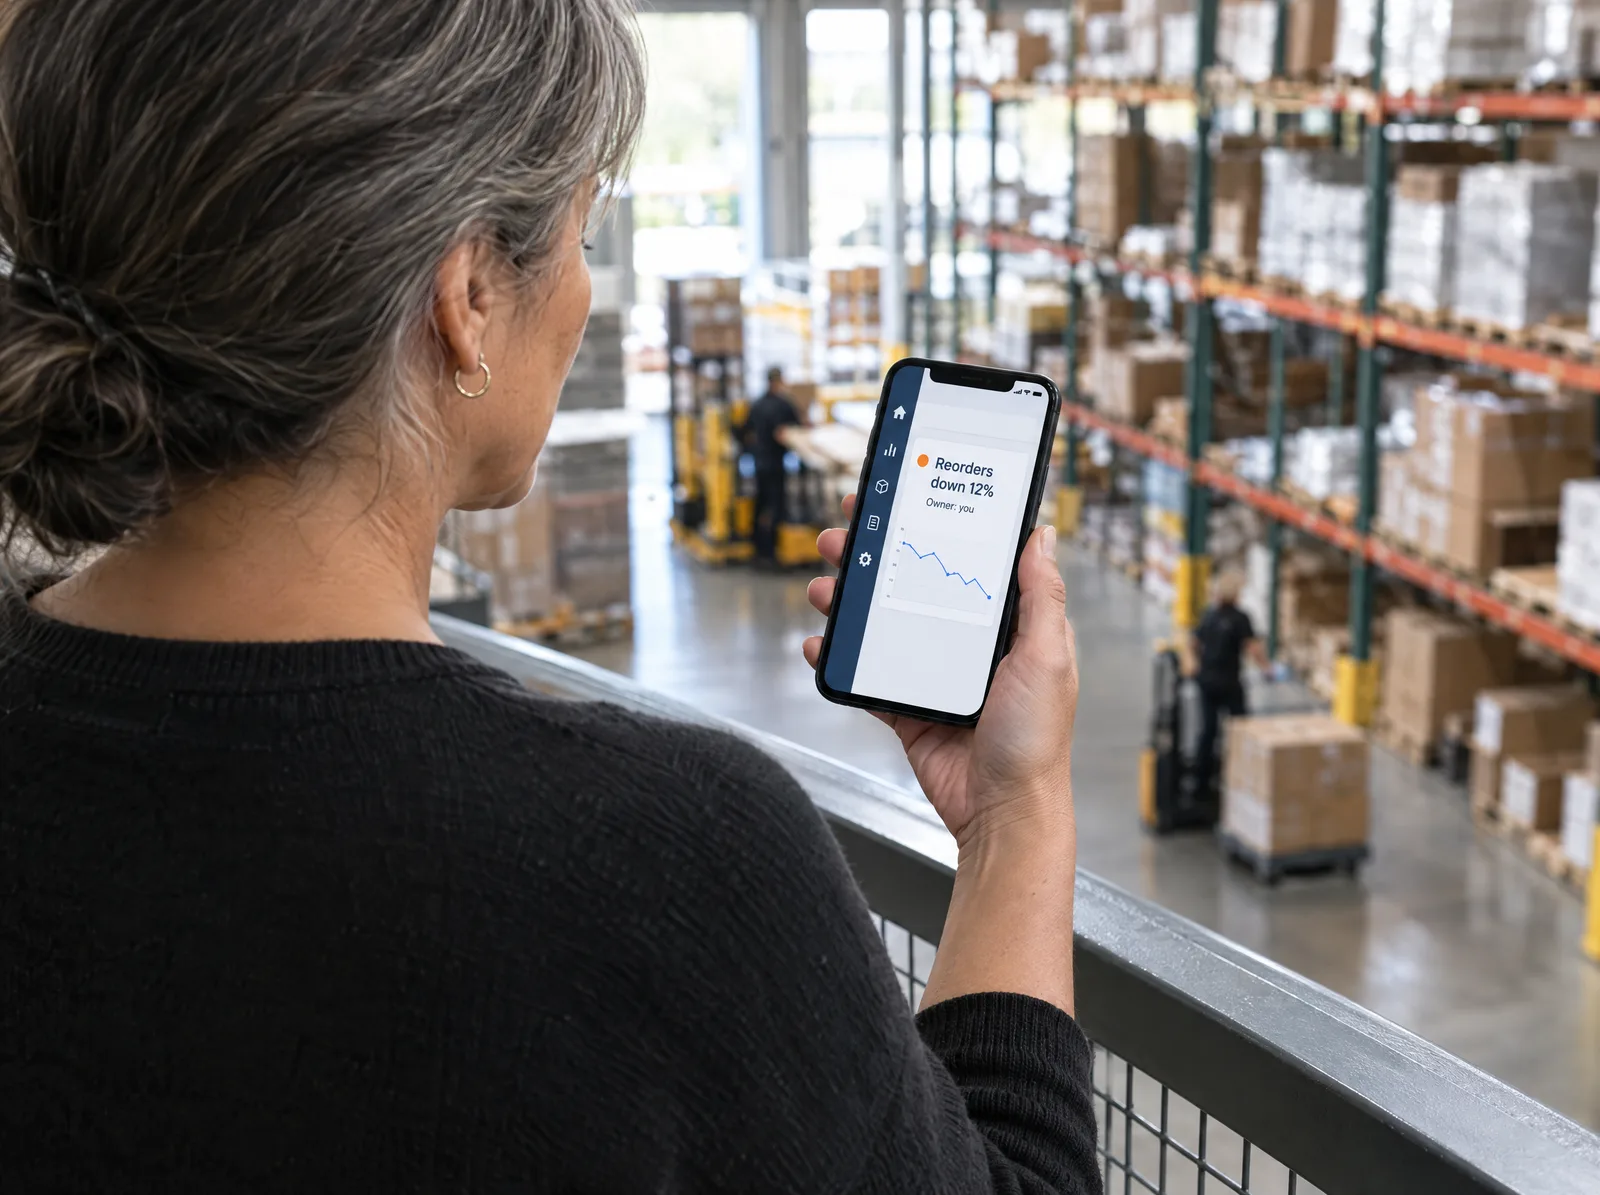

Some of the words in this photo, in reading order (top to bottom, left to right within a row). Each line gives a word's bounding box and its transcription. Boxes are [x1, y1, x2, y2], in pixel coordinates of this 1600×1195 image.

[935, 457, 994, 478] Reorders
[930, 476, 966, 493] down
[970, 482, 994, 498] 12%
[926, 497, 957, 511] Owner:
[958, 505, 975, 514] you
